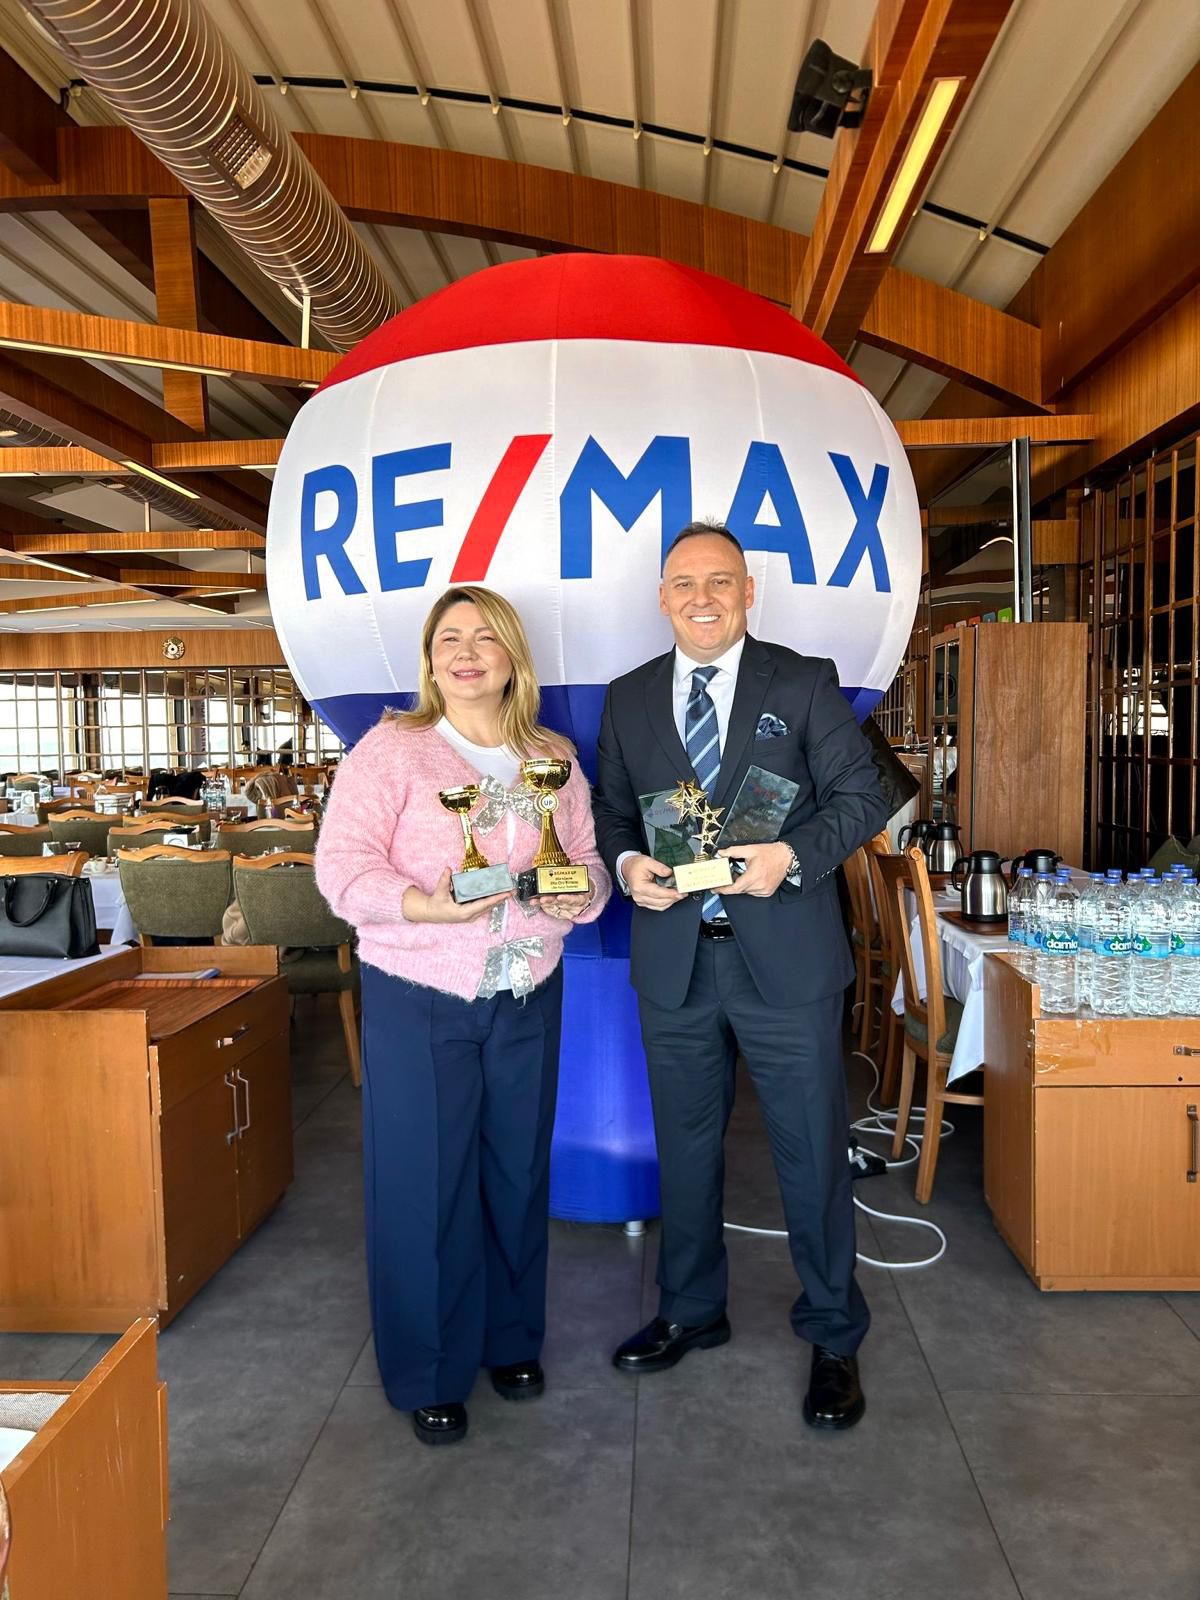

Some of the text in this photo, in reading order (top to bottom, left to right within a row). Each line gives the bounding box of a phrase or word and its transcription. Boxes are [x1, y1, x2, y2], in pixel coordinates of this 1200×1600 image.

[301, 435, 891, 601] RE/MAX
[1046, 939, 1078, 949] damla
[1110, 941, 1132, 950] dam
